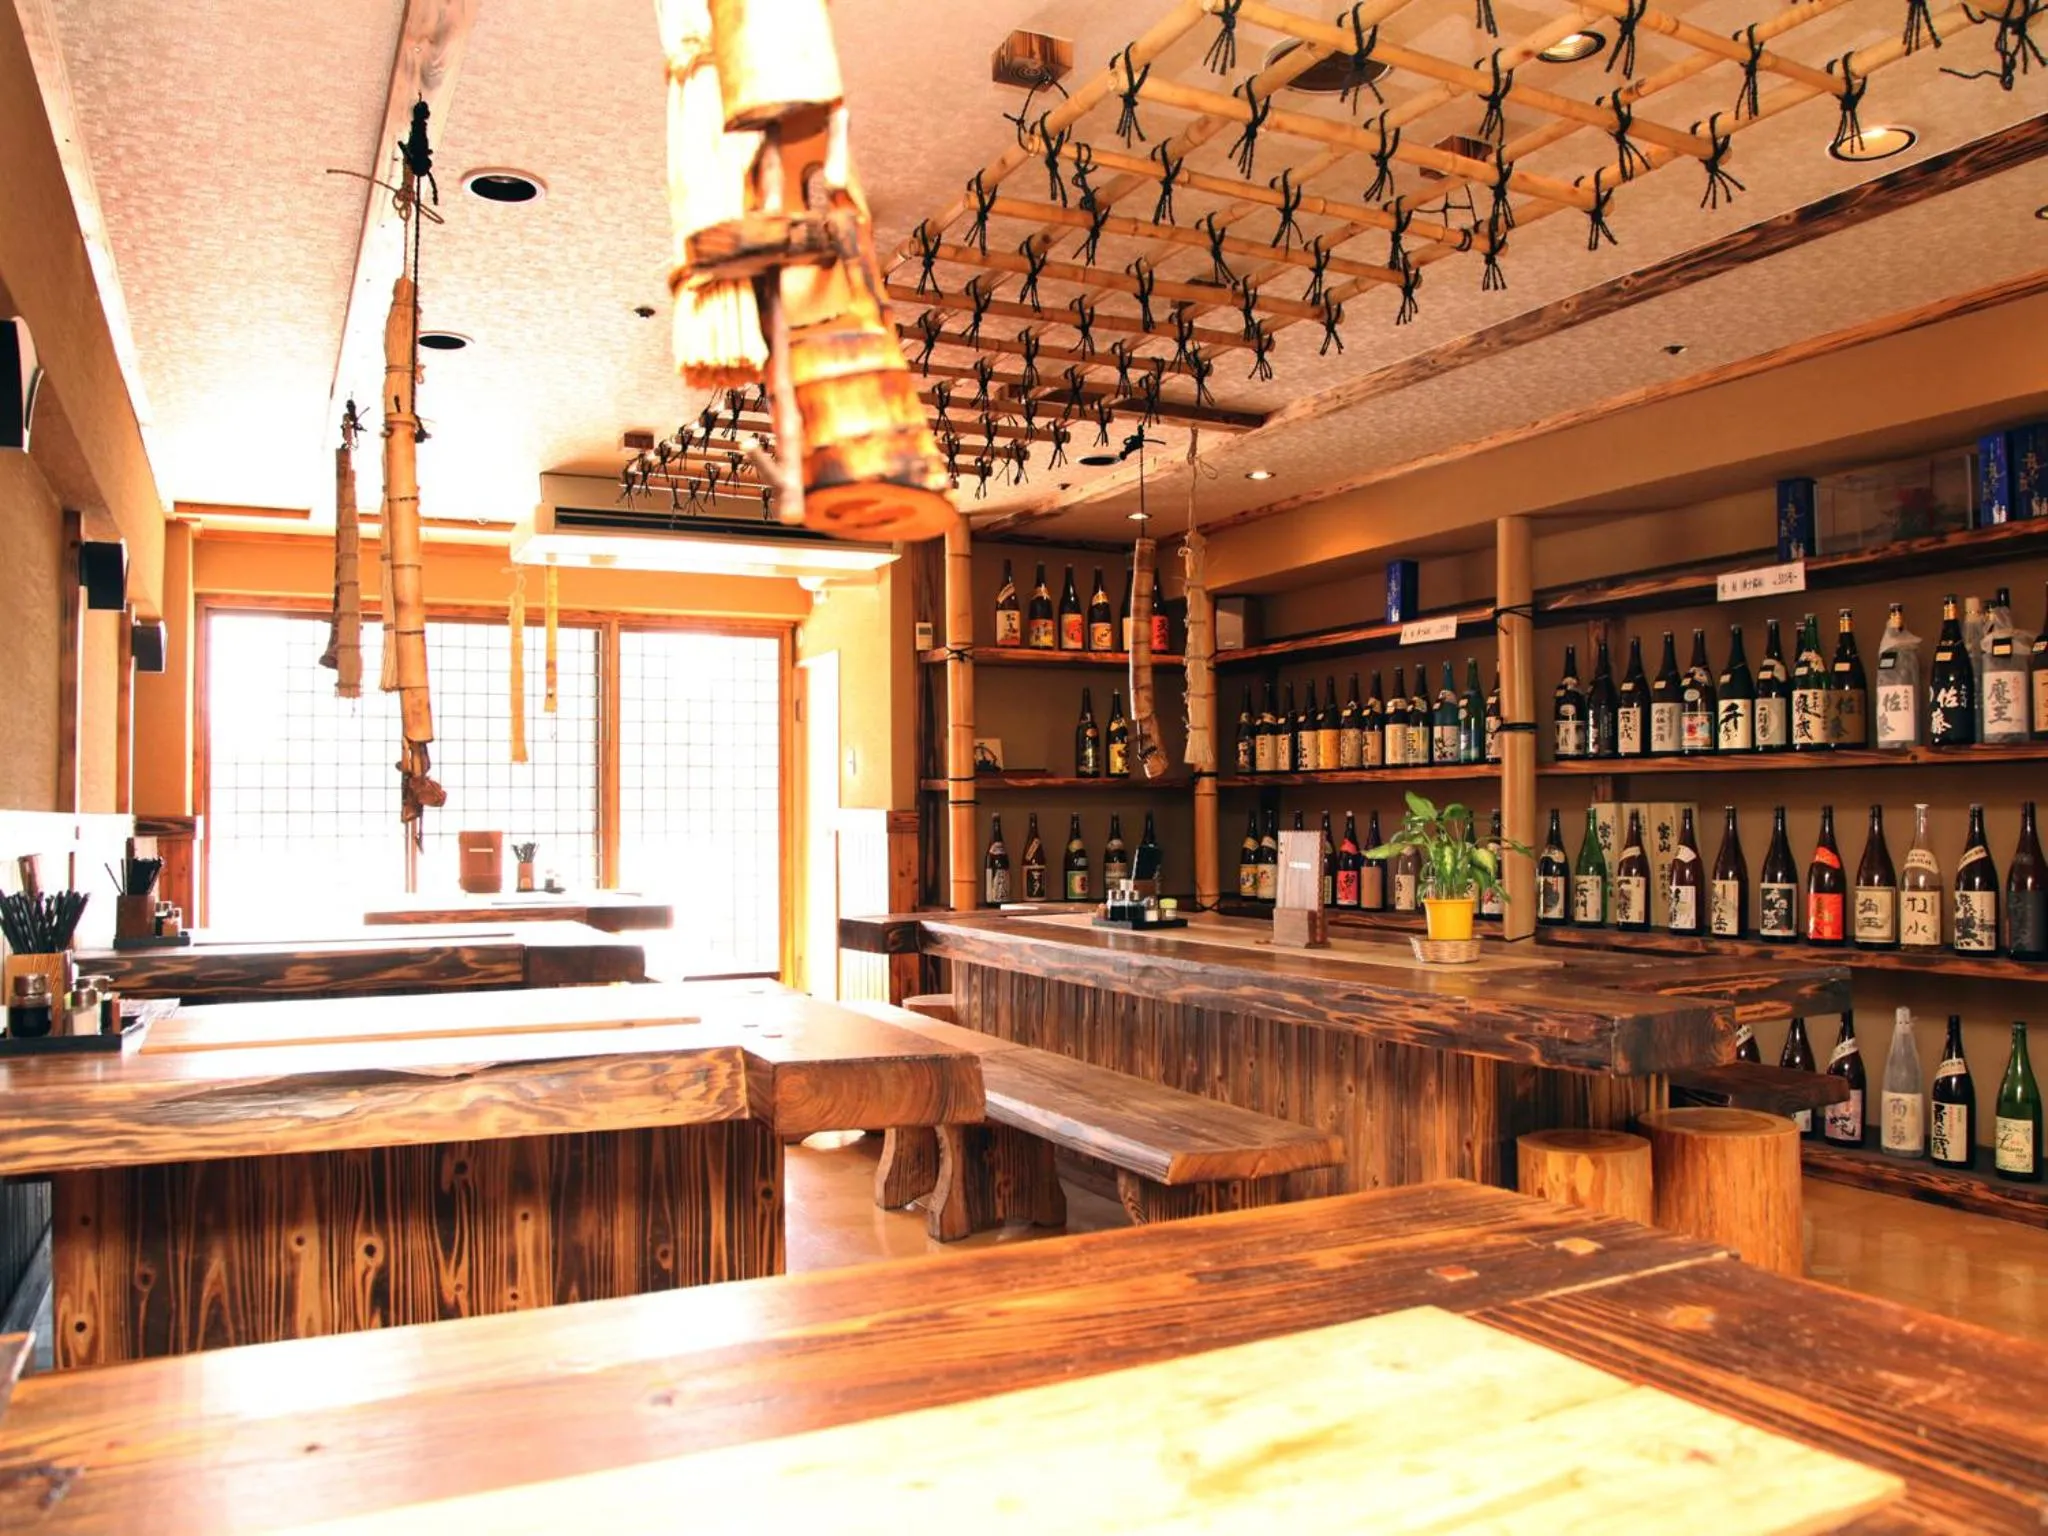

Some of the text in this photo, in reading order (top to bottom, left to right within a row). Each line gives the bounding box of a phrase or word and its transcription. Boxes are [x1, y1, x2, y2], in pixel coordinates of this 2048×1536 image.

[1931, 686, 1959, 734] 佐藤
[1987, 678, 2012, 724] 魔王
[1598, 820, 1612, 851] 宝山
[1657, 821, 1671, 853] 宝山
[1858, 898, 1885, 930] 角玉
